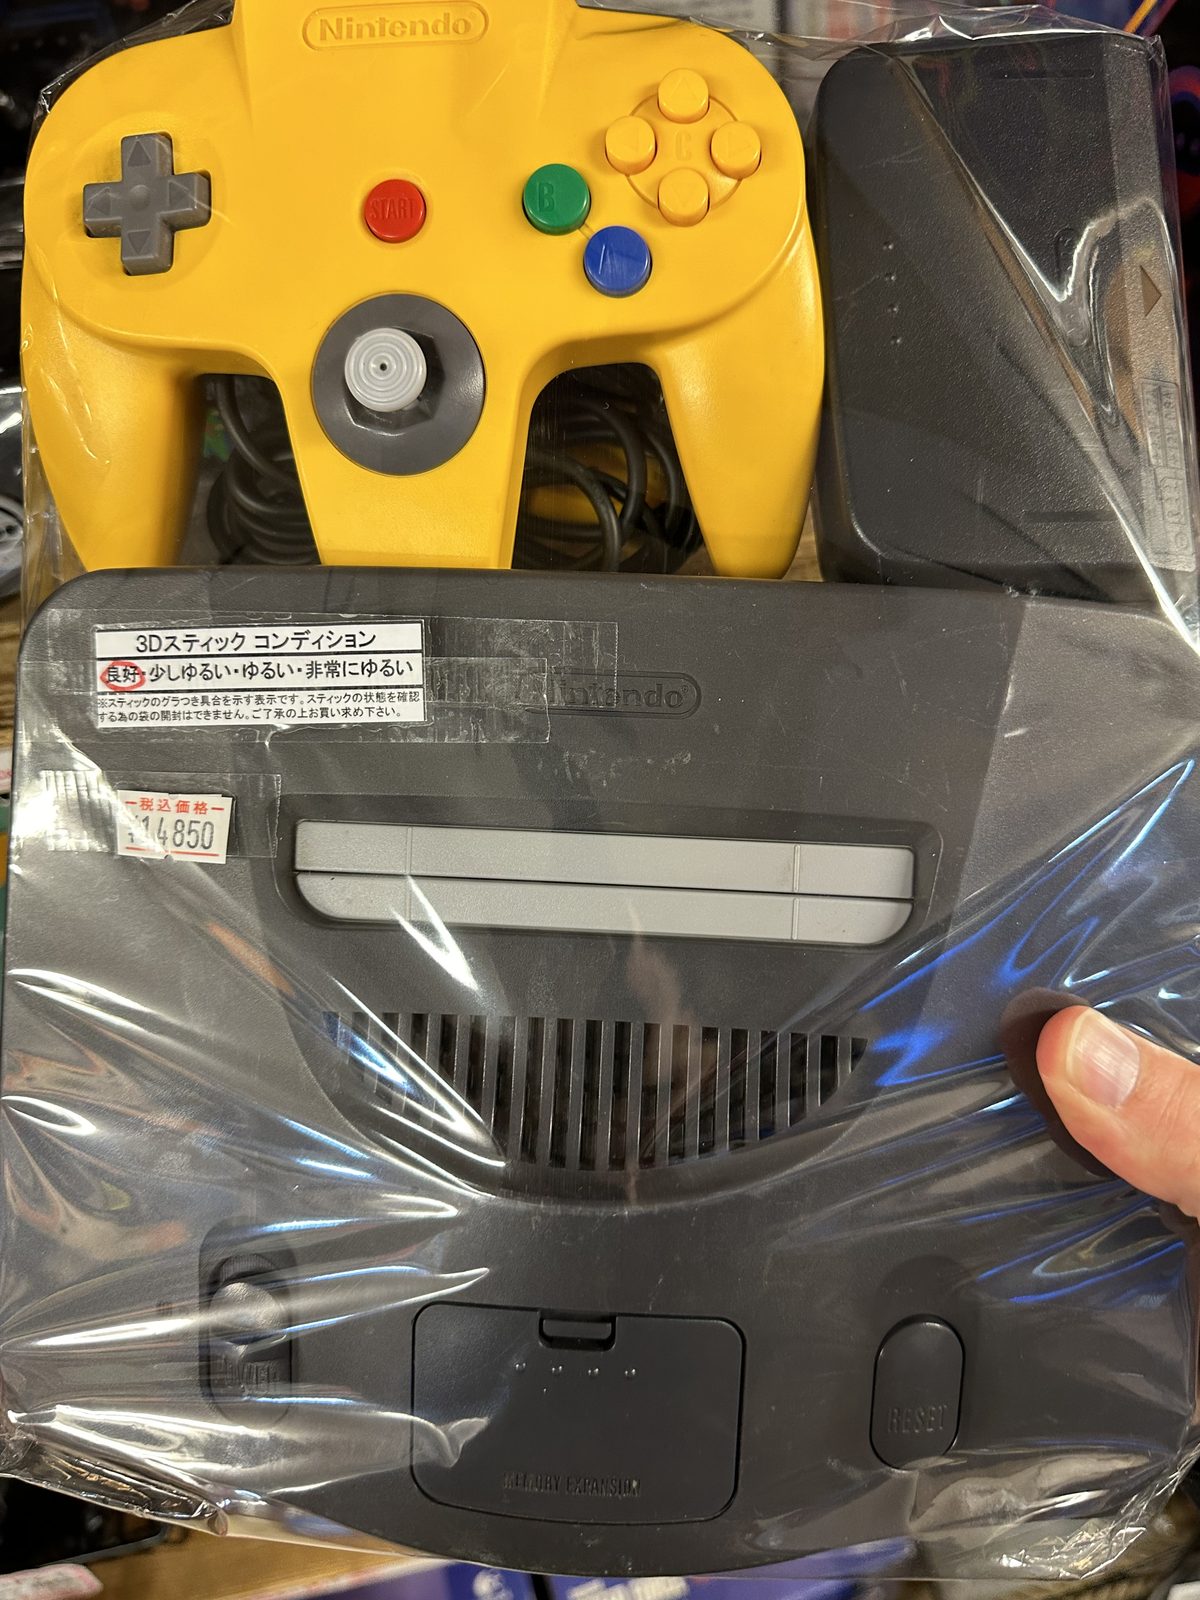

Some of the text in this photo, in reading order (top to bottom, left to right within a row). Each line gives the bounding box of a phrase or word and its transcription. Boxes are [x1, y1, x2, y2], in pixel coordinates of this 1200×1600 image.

[320, 12, 472, 41] Nintendo
[369, 197, 415, 220] START
[537, 181, 555, 213] B
[139, 797, 209, 815] 税込価格
[888, 1404, 948, 1434] RESET
